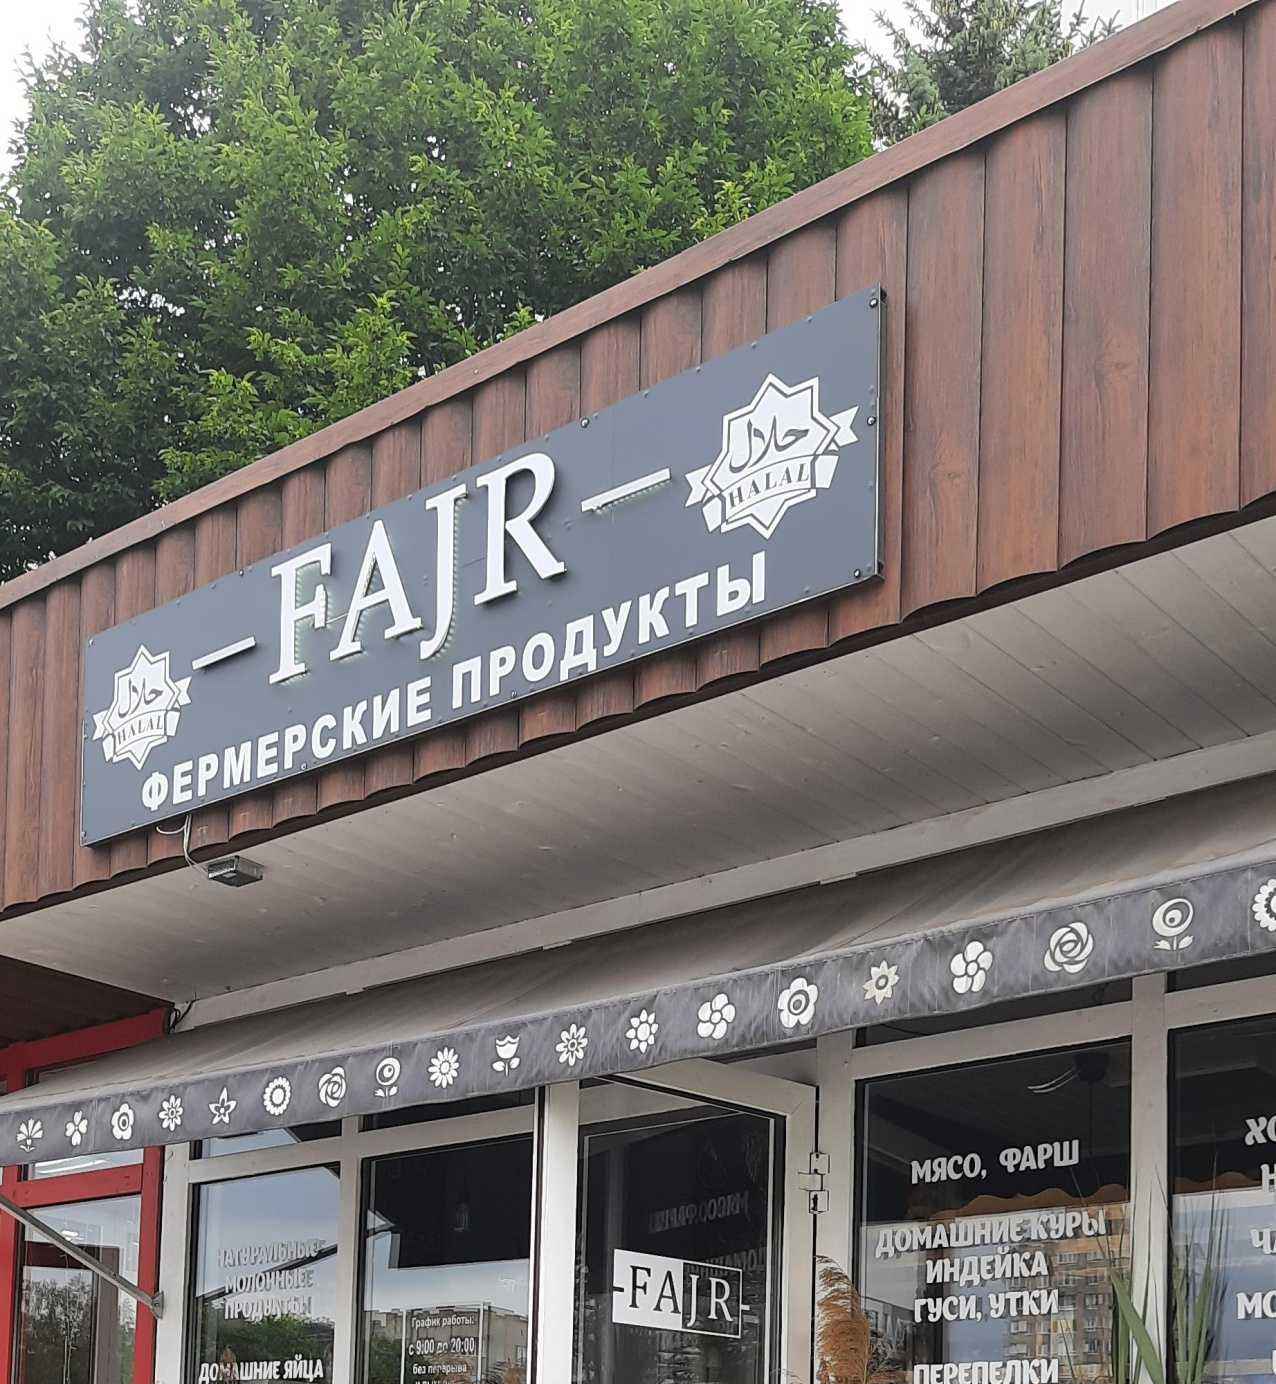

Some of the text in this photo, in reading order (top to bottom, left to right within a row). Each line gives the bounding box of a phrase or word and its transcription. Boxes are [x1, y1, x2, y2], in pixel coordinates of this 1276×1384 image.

[728, 415, 810, 474] حلال
[728, 463, 810, 508] HALAL
[269, 452, 568, 684] FAJR
[141, 550, 766, 811] ФЕРМЕРСКИЕ ПРОДУКТЫ
[117, 715, 163, 745] HALAL
[911, 1139, 1080, 1184] МЯСО, ФАРШ
[875, 1208, 1107, 1258] ДОМАШНИЕ КУРЫ
[1250, 1228, 1276, 1255] Ч
[925, 1245, 1048, 1287] ИНДЕЙКА
[629, 1265, 734, 1328] FAJR
[914, 1288, 1059, 1323] ГУСИ, УТКИ
[411, 1313, 475, 1331] График работы:
[416, 1338, 435, 1355] 9:00
[450, 1337, 475, 1353] 20:00
[283, 1354, 324, 1382] ЯЙЦА
[412, 1363, 427, 1375] без
